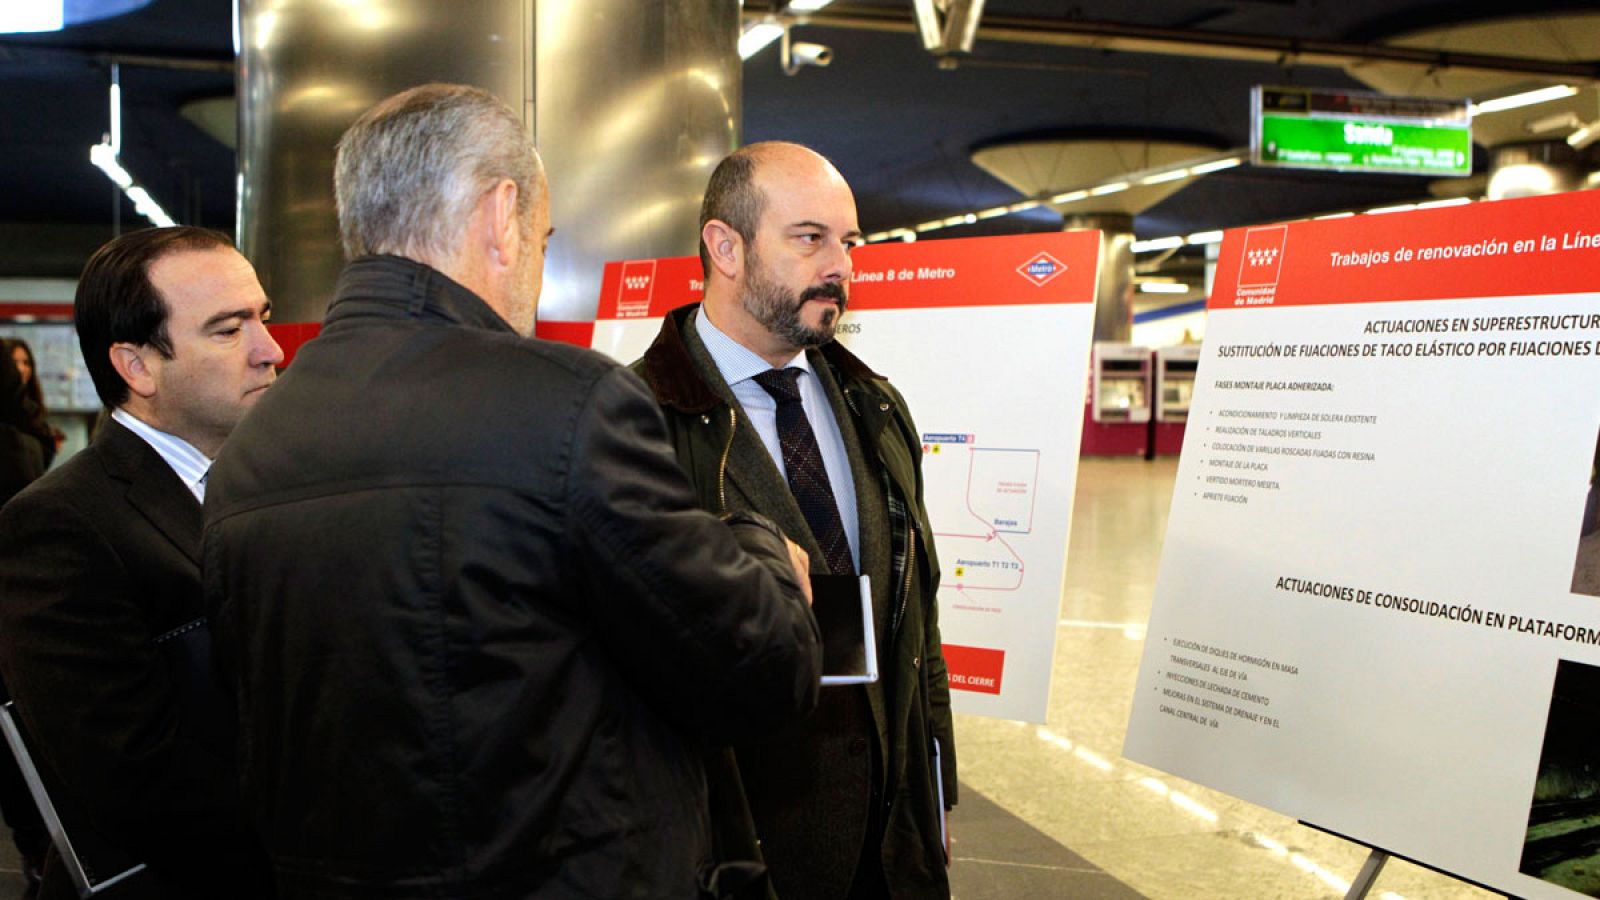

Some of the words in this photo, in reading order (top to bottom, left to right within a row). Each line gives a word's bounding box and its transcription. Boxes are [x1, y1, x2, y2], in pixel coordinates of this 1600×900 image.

[1330, 249, 1390, 268] Trabajos
[1394, 247, 1413, 262] de
[1417, 237, 1508, 260] renovación
[1513, 239, 1535, 253] en
[1540, 235, 1557, 251] la
[850, 271, 884, 282] Línea
[887, 269, 896, 281] 8
[898, 268, 914, 280] de
[917, 267, 956, 279] Metro
[1031, 264, 1053, 273] Metro
[1236, 287, 1277, 297] Comunidad
[1234, 297, 1245, 305] de
[1247, 295, 1275, 305] Madrid
[832, 323, 862, 334] EROS
[1363, 319, 1450, 334] ACTUACIONES
[1451, 318, 1470, 332] EN
[1472, 314, 1600, 332] SUPERESTRUCTUR
[1217, 341, 1281, 357] SUSTITUCIÓN
[1283, 344, 1298, 357] DE
[1299, 343, 1360, 357] FIJACIONES
[1362, 343, 1378, 357] DE
[1380, 343, 1413, 357] TACO
[1415, 339, 1475, 356] ELÁSTICO
[1477, 342, 1507, 356] POR
[1508, 340, 1592, 356] FIJACIONES
[1214, 380, 1234, 389] FASES
[1234, 381, 1265, 390] MONTAJE
[1265, 382, 1287, 391] PLACA
[1311, 412, 1320, 422] DE
[1320, 413, 1344, 423] SOLERA
[1344, 414, 1377, 425] EXISTENTE
[1249, 428, 1257, 436] DE
[1287, 430, 1321, 440] VERTICALES
[1247, 445, 1256, 453] DE
[1336, 450, 1352, 460] CON
[1352, 452, 1376, 462] RESINA
[1276, 577, 1354, 601] ACTUACIONES
[1356, 588, 1372, 604] DE
[1375, 592, 1482, 625] CONSOLIDACIÓN
[1485, 611, 1505, 628] EN
[1507, 614, 1600, 646] PLATAFORM
[1201, 645, 1209, 654] DE
[1230, 651, 1238, 661] DE
[952, 674, 966, 684] DEL
[967, 676, 995, 688] CIERRE
